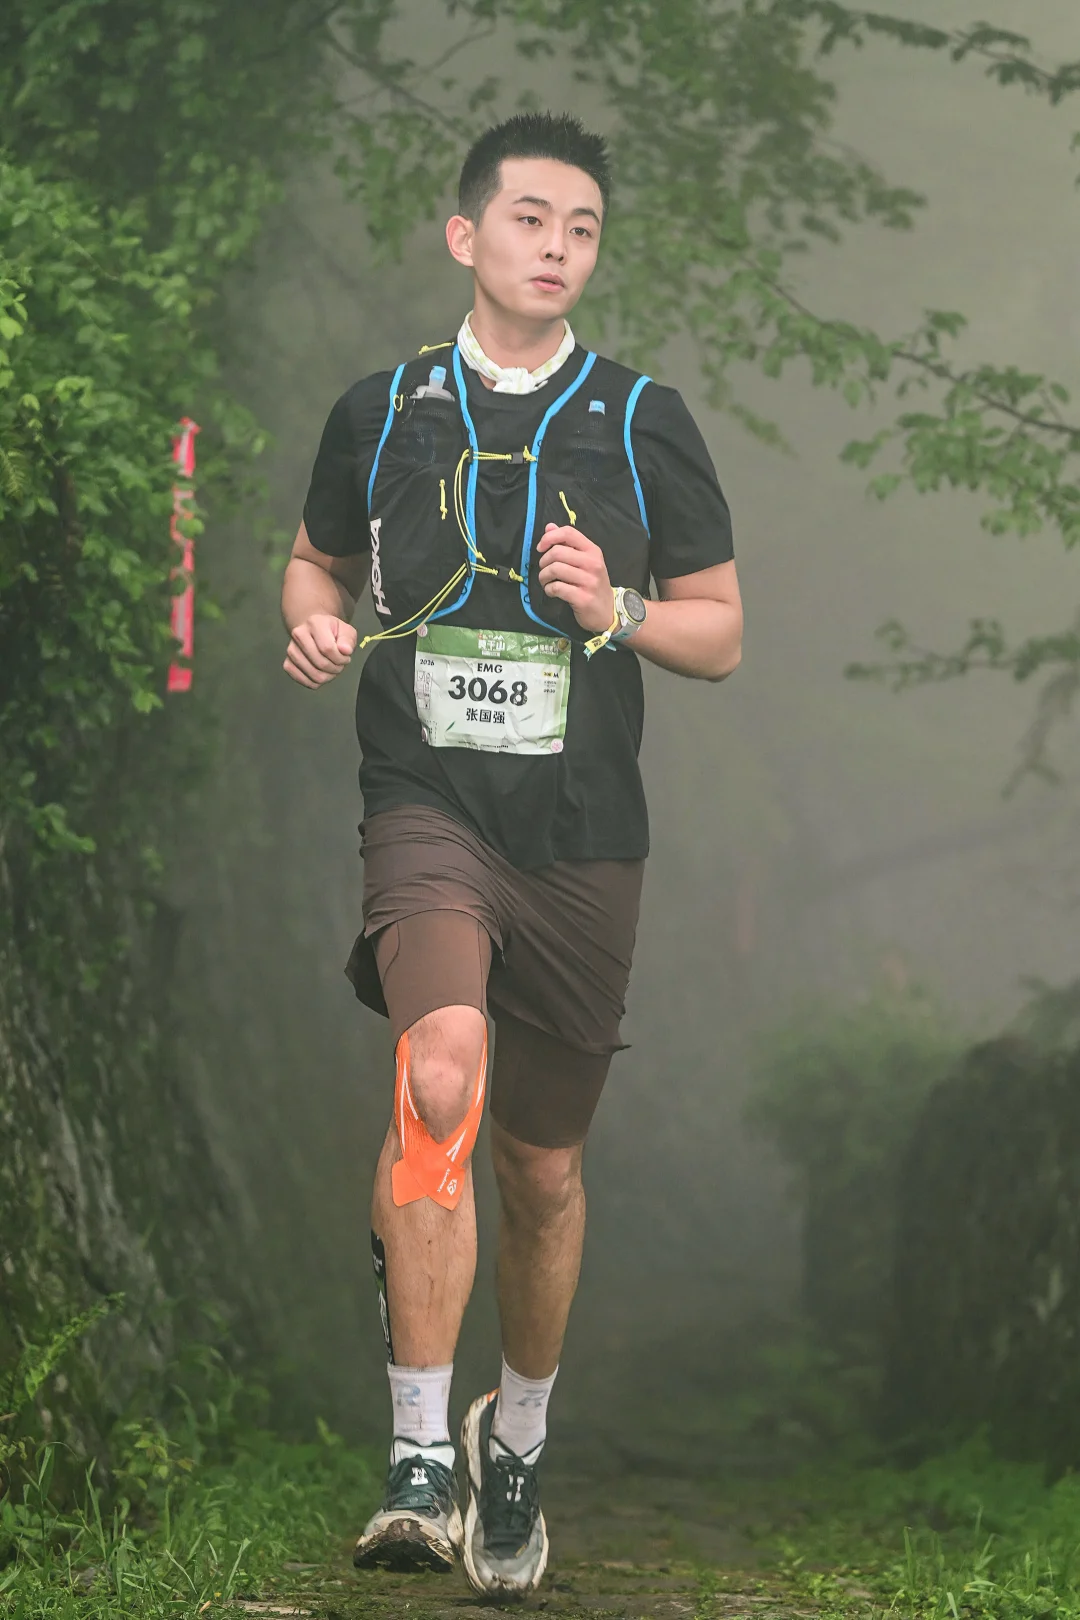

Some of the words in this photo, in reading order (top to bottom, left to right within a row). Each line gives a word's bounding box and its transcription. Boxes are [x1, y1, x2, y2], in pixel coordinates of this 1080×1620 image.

[369, 517, 391, 615] HOKA
[477, 662, 503, 673] EMG
[447, 675, 528, 707] 3068
[466, 707, 506, 724] 张国强
